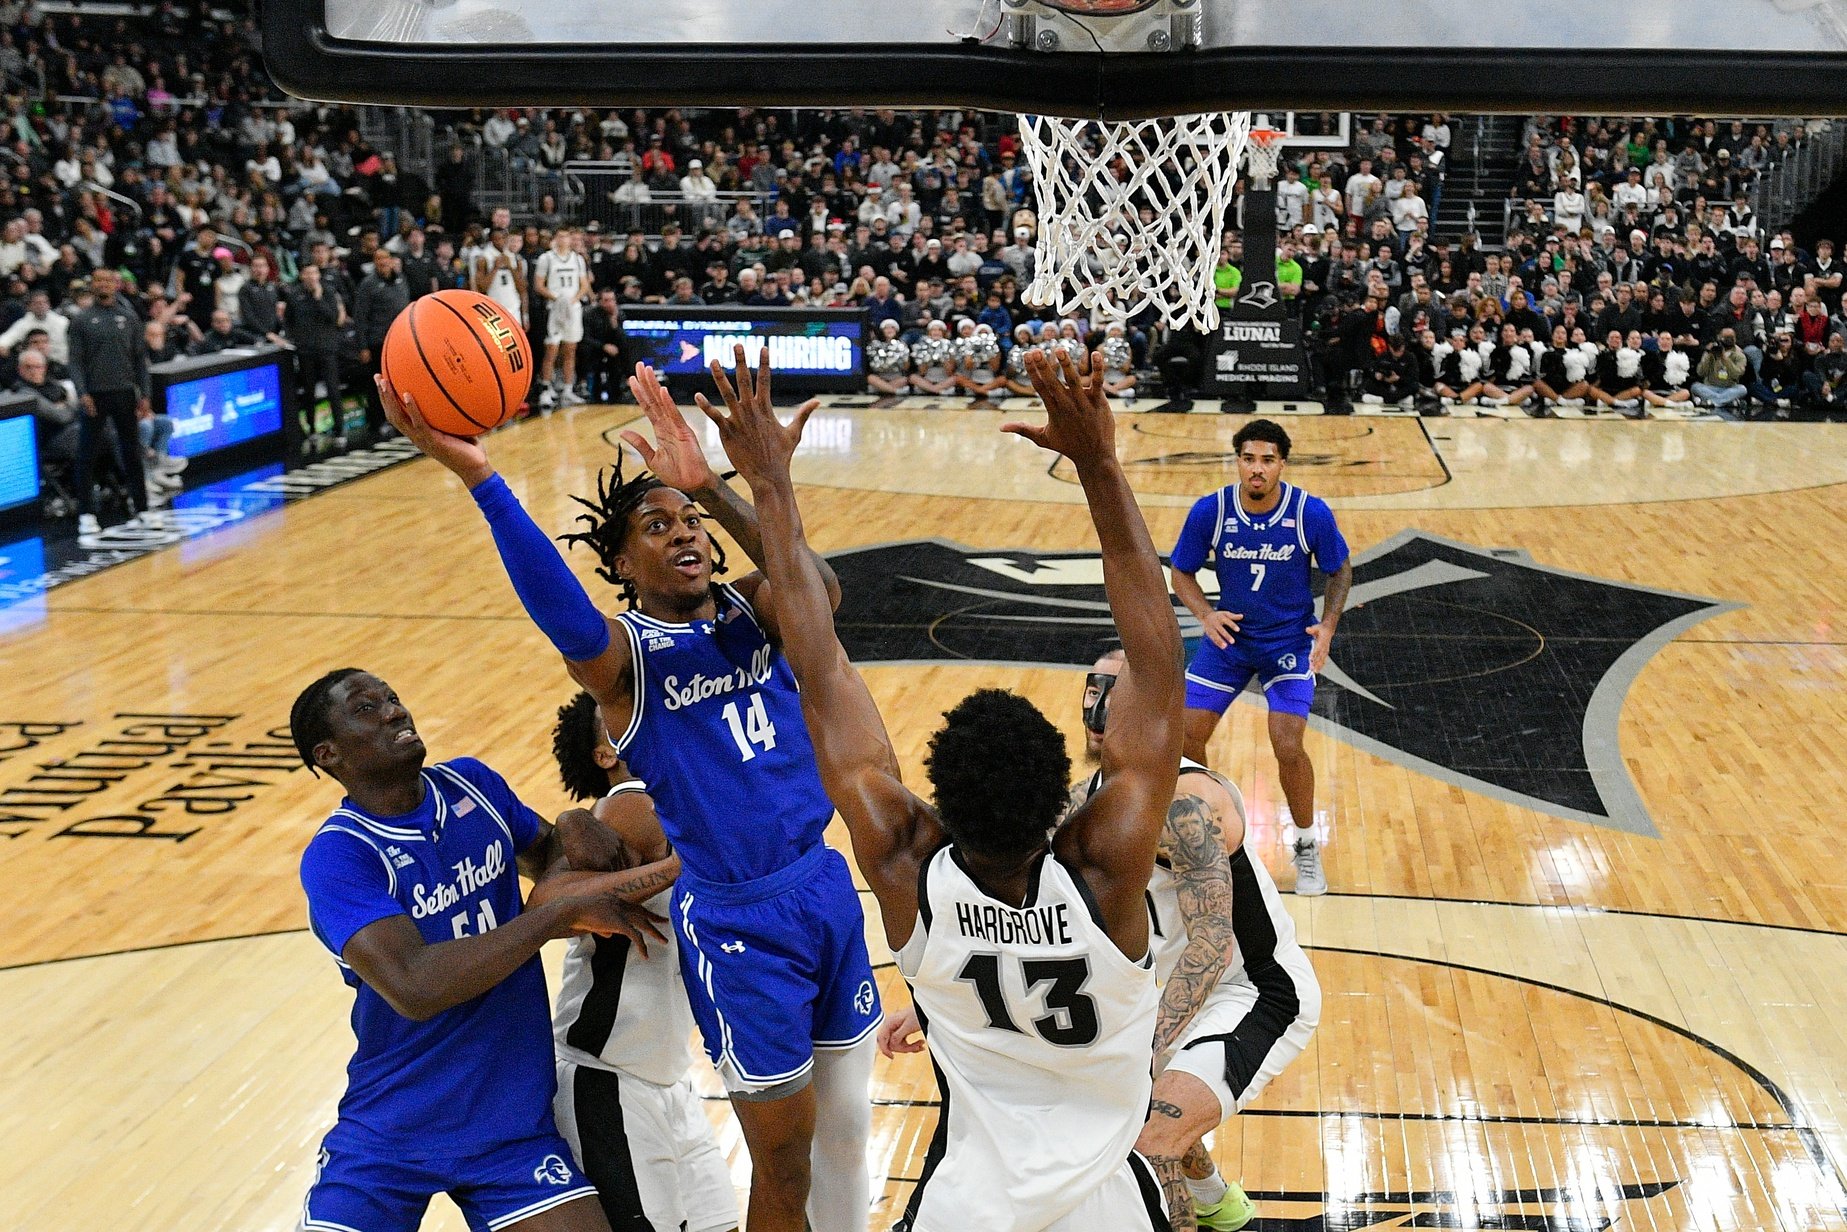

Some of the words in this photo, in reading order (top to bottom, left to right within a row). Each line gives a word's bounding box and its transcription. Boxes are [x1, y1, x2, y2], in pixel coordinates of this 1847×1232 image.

[703, 334, 765, 369] NOW
[768, 335, 852, 371] HIRING
[1268, 363, 1299, 373] ISLAND
[1215, 373, 1257, 382] MEDICAL
[1257, 374, 1299, 383] IMAGING
[1223, 542, 1258, 560] Seton
[1258, 543, 1296, 561] Hall
[1250, 563, 1266, 592] 7
[648, 640, 675, 652] CHANGE
[664, 673, 735, 711] Seton
[721, 692, 777, 763] 14
[411, 882, 460, 919] Seton
[451, 839, 506, 897] Hall
[955, 902, 1073, 945] HARGROVE
[952, 949, 1102, 1049] 13
